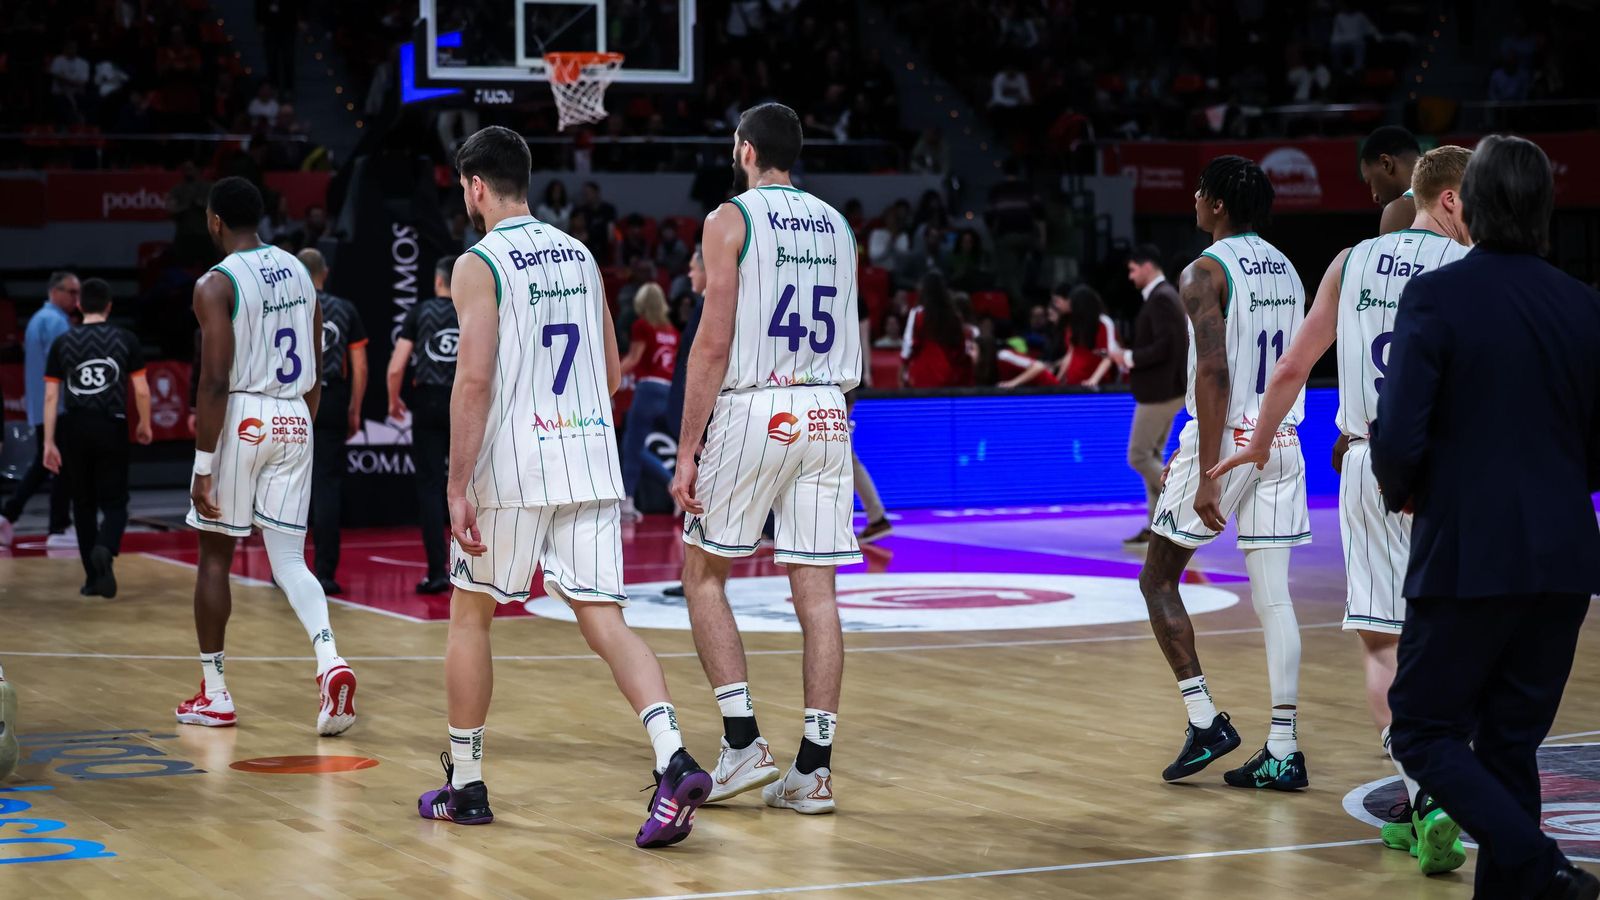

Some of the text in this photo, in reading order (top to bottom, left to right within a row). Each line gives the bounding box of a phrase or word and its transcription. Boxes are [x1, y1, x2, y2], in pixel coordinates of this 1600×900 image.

[767, 211, 835, 234] Kravish
[509, 243, 586, 271] Barreiro
[1239, 257, 1287, 276] Carter
[1376, 254, 1425, 278] Díaz
[260, 266, 293, 288] Ejim
[768, 284, 837, 354] 45
[274, 328, 301, 384] 3
[542, 323, 580, 395] 7
[1256, 329, 1283, 394] 11
[80, 367, 106, 387] 83
[272, 417, 308, 426] COSTA
[808, 409, 846, 420] COSTA
[272, 427, 308, 436] DEL SOL
[808, 422, 830, 432] DEL
